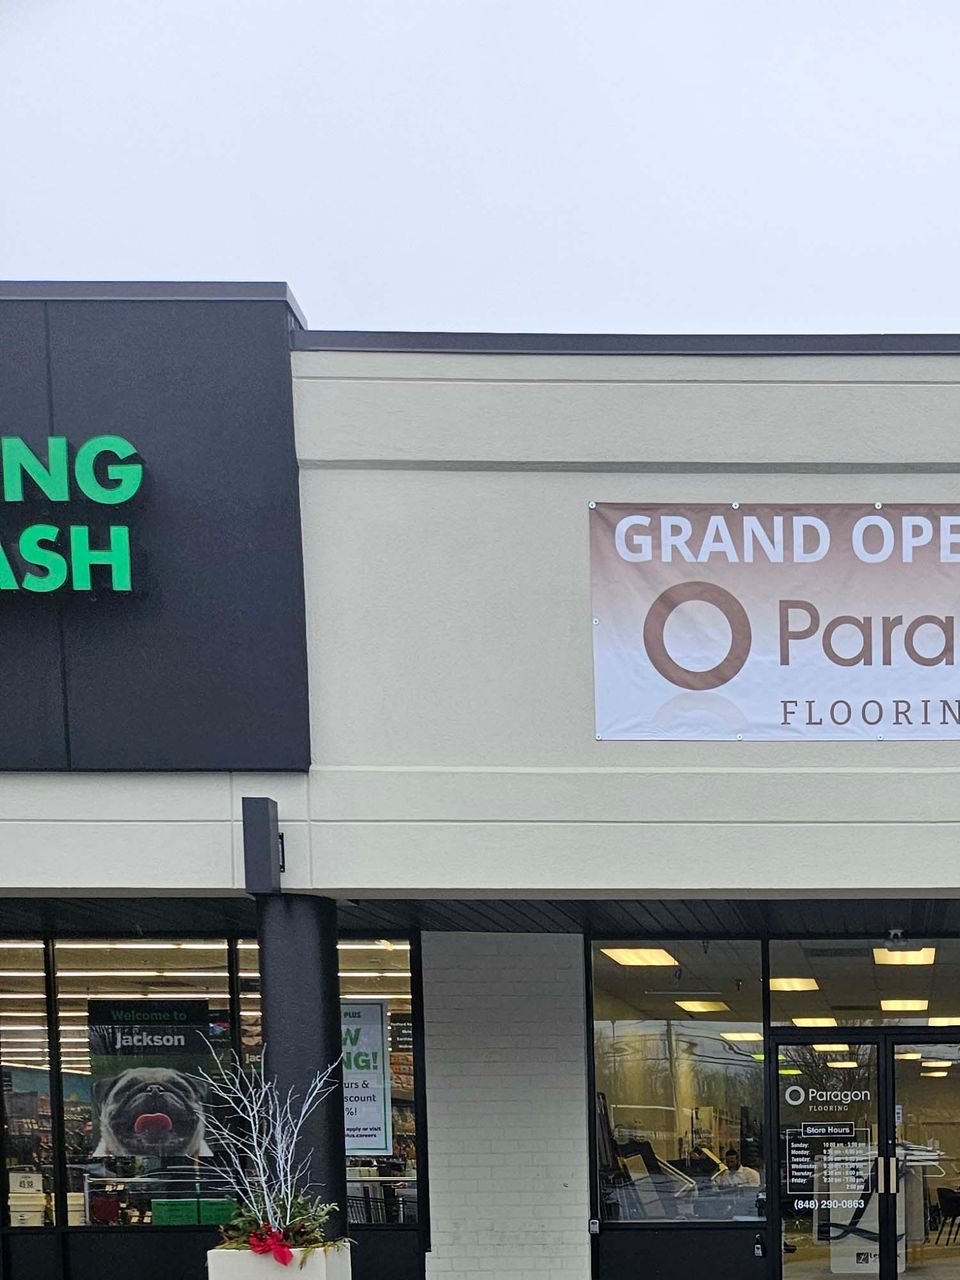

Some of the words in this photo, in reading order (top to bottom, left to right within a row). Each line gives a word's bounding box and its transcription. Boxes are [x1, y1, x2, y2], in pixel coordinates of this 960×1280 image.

[0, 434, 143, 504] NG
[614, 514, 831, 564] GRAND
[111, 1010, 170, 1021] Welcome
[173, 1010, 187, 1021] to
[115, 1032, 185, 1049] Jackson
[361, 1080, 369, 1088] &
[808, 1088, 870, 1104] Paragon
[806, 1126, 826, 1134] Store
[794, 1199, 819, 1210] (848)
[821, 1200, 865, 1209] 290-0863
